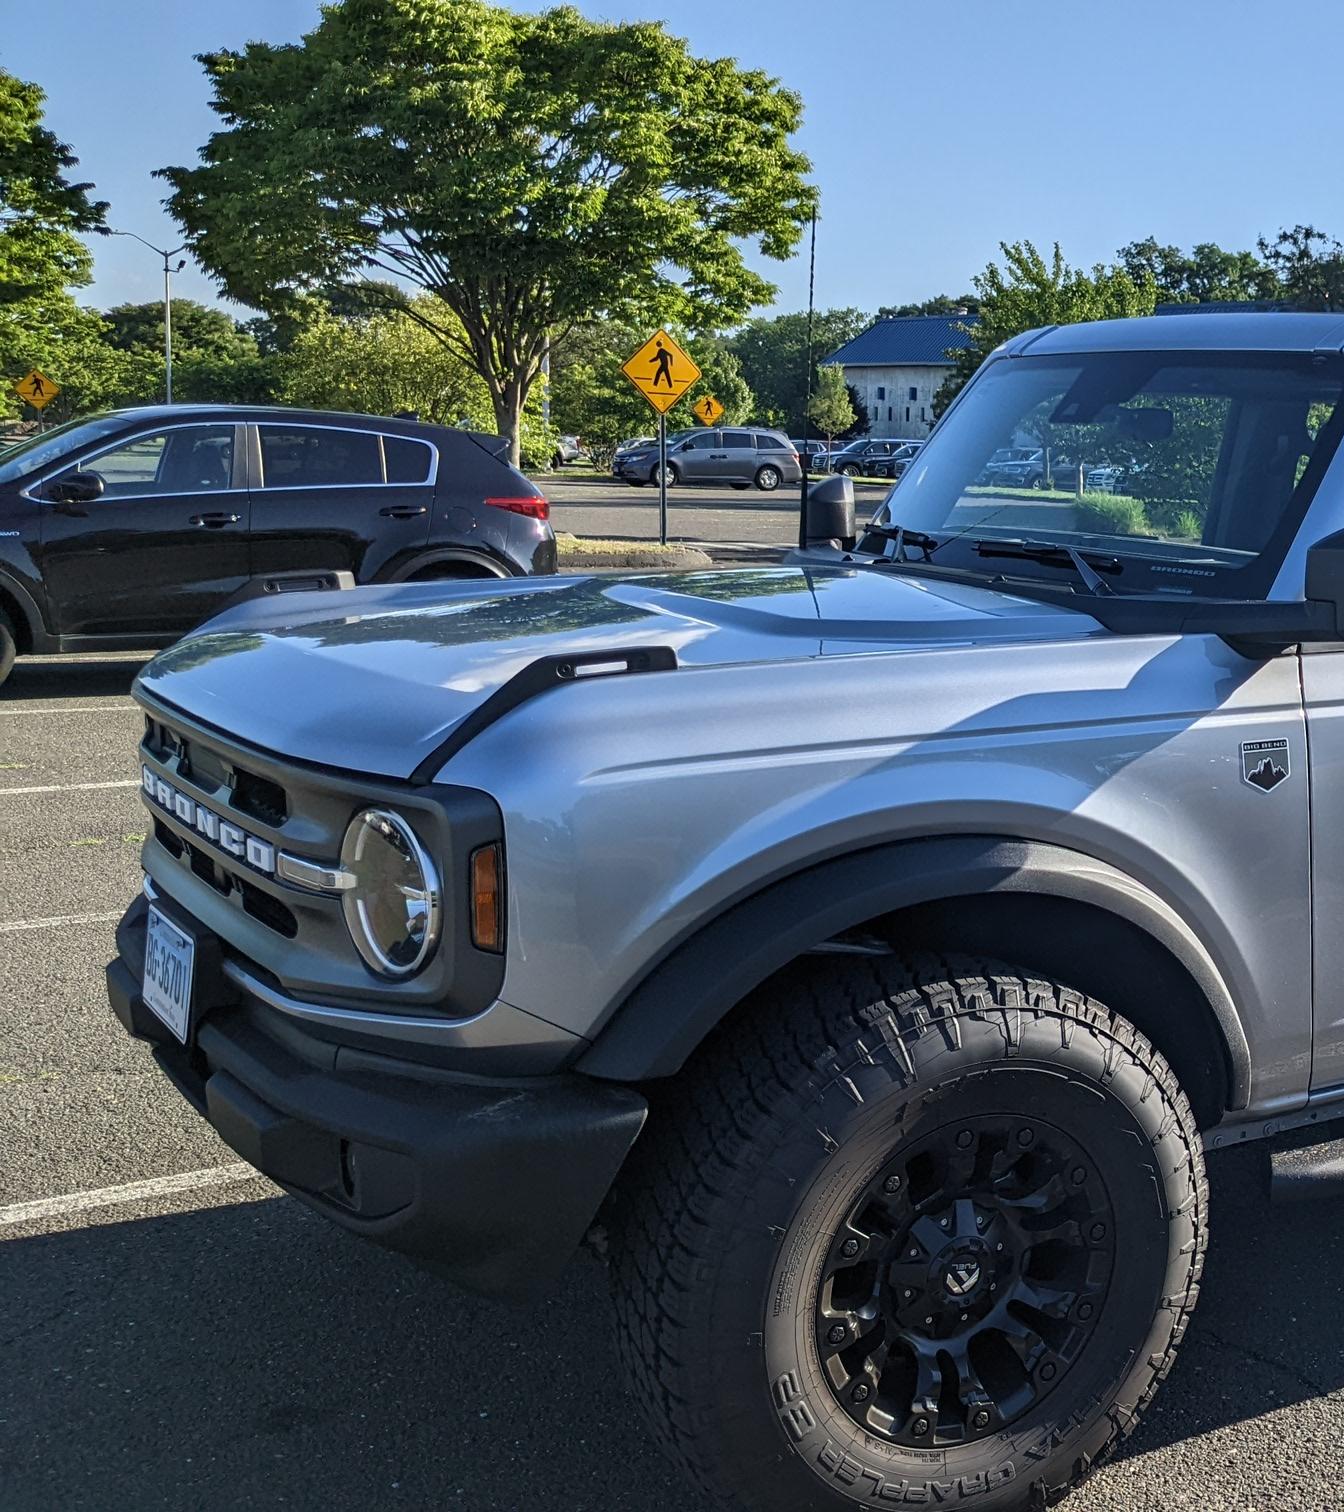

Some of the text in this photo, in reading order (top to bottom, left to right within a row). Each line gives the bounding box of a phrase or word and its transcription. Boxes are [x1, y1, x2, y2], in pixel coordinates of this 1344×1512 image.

[1261, 741, 1287, 749] BEND
[143, 764, 276, 873] BRONCO
[951, 1261, 978, 1271] FUEL
[817, 1438, 1017, 1503] GRAPPLER
